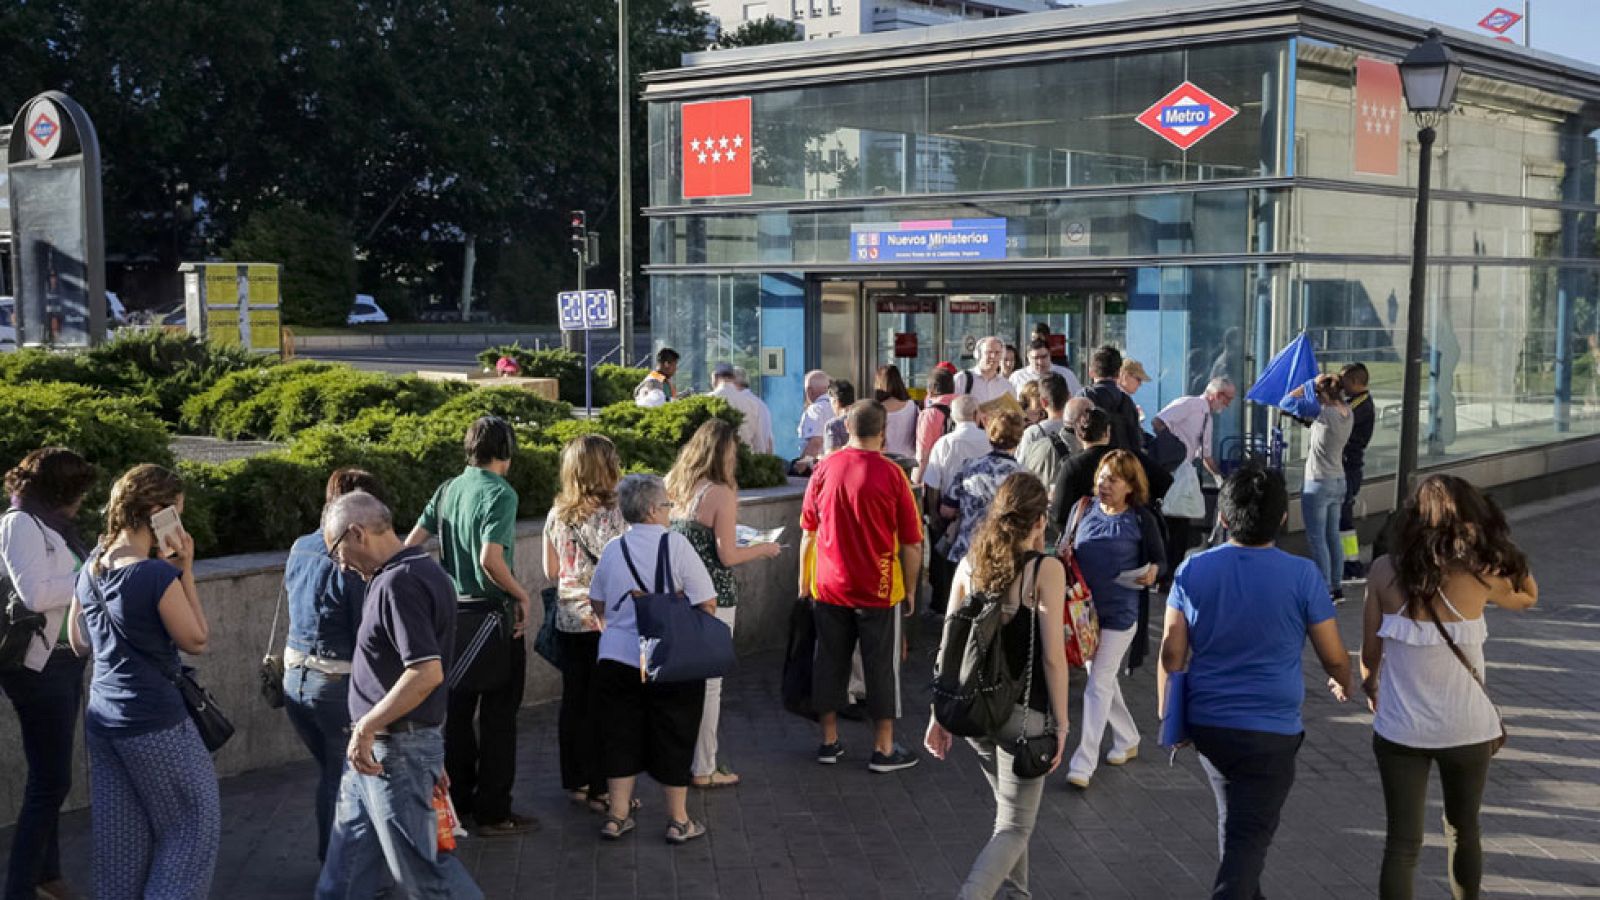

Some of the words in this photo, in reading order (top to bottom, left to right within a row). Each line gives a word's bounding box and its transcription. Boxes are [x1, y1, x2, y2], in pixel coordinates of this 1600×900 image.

[1165, 110, 1206, 124] Metro
[887, 234, 927, 246] Nuevos
[928, 231, 989, 247] Ministerios
